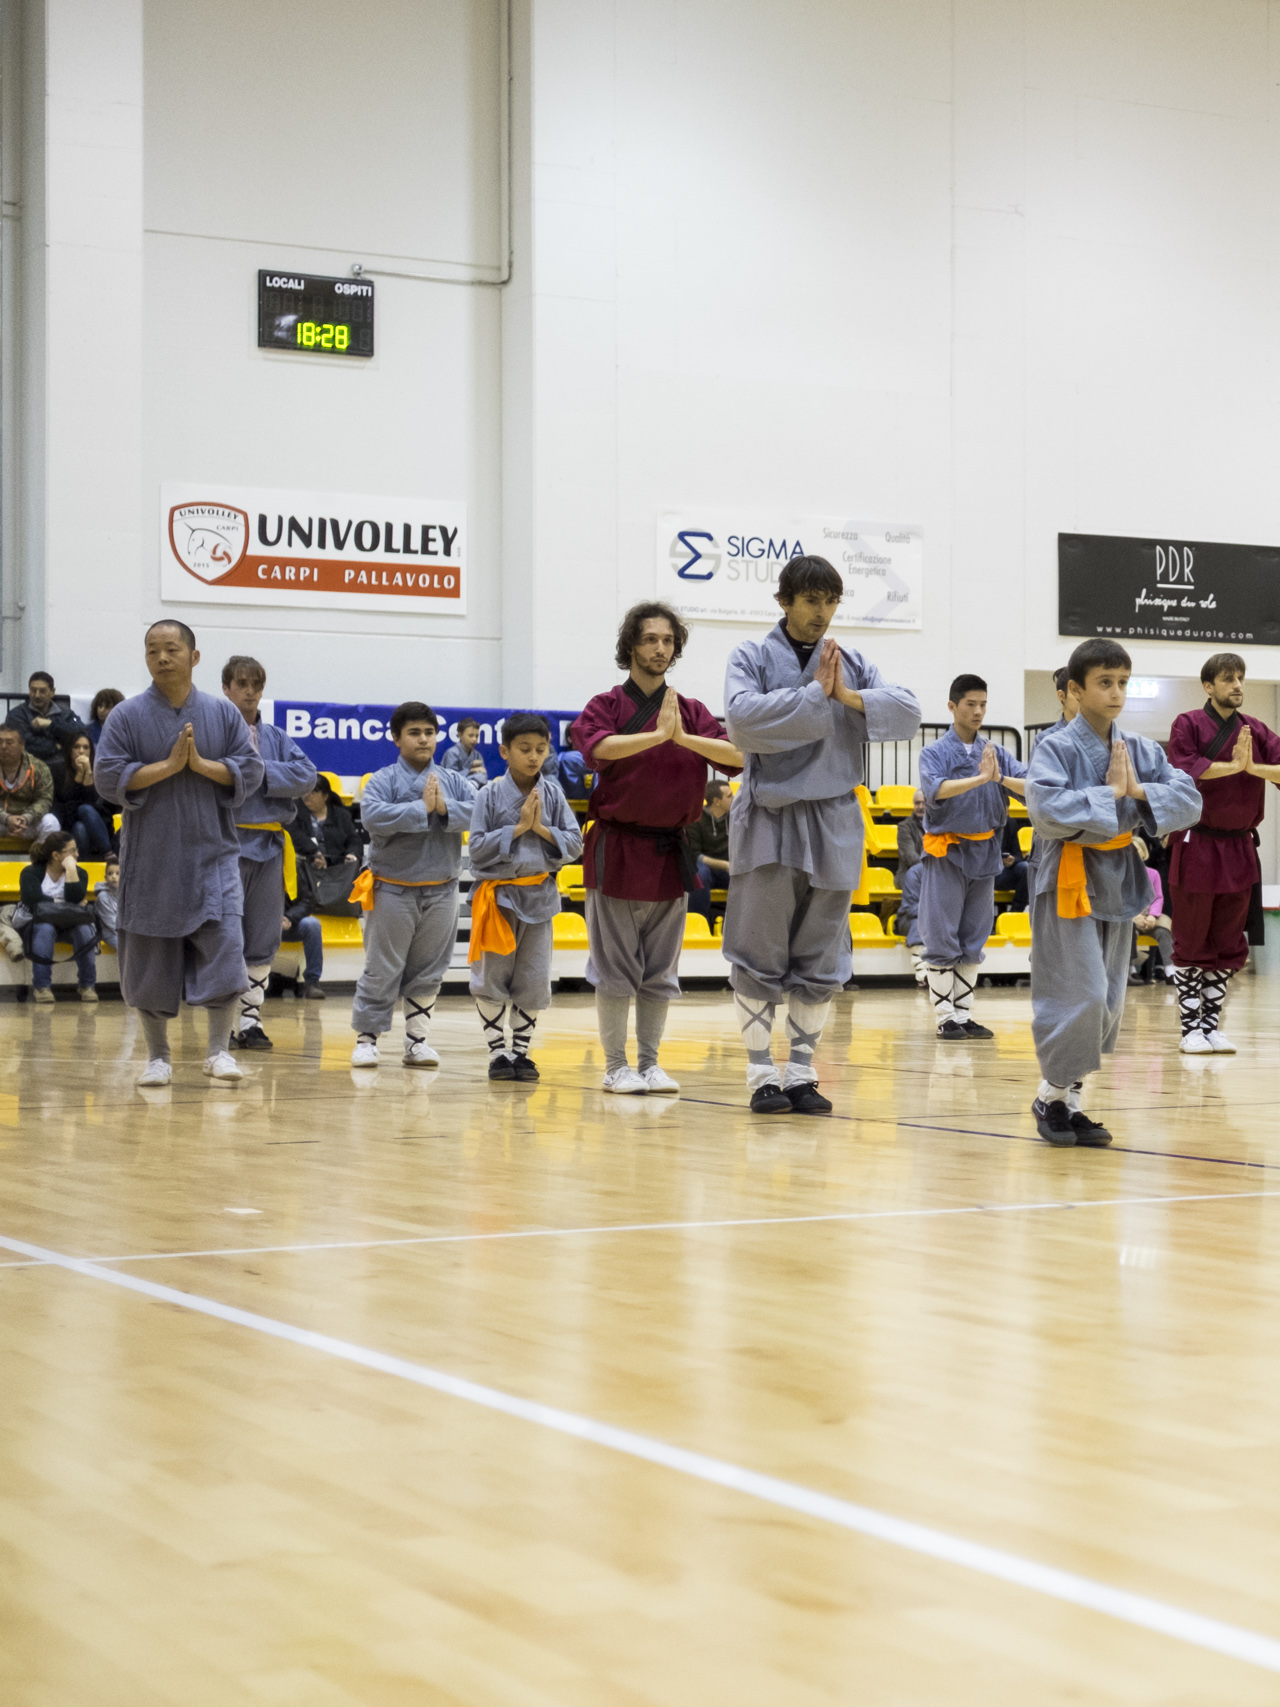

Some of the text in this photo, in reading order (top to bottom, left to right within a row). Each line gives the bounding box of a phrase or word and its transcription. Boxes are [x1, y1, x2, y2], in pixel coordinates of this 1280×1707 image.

[266, 276, 372, 297] LOCALI OSPITI
[297, 322, 348, 349] 18:28
[179, 507, 239, 520] UNIVOLLEY
[216, 524, 239, 532] CARPI
[257, 513, 458, 557] UNIVOLLEY
[822, 527, 858, 540] Sicurezza
[727, 535, 804, 560] SIGMA
[842, 550, 892, 565] Certificazione
[1156, 545, 1194, 583] PDR
[257, 564, 456, 589] CARPI PALLAVOLO
[727, 559, 785, 584] STUD
[848, 563, 887, 578] Energetica
[887, 591, 909, 603] Rifiuti
[1180, 596, 1196, 607] du
[1096, 625, 1254, 639] www.phisiquedurole.com
